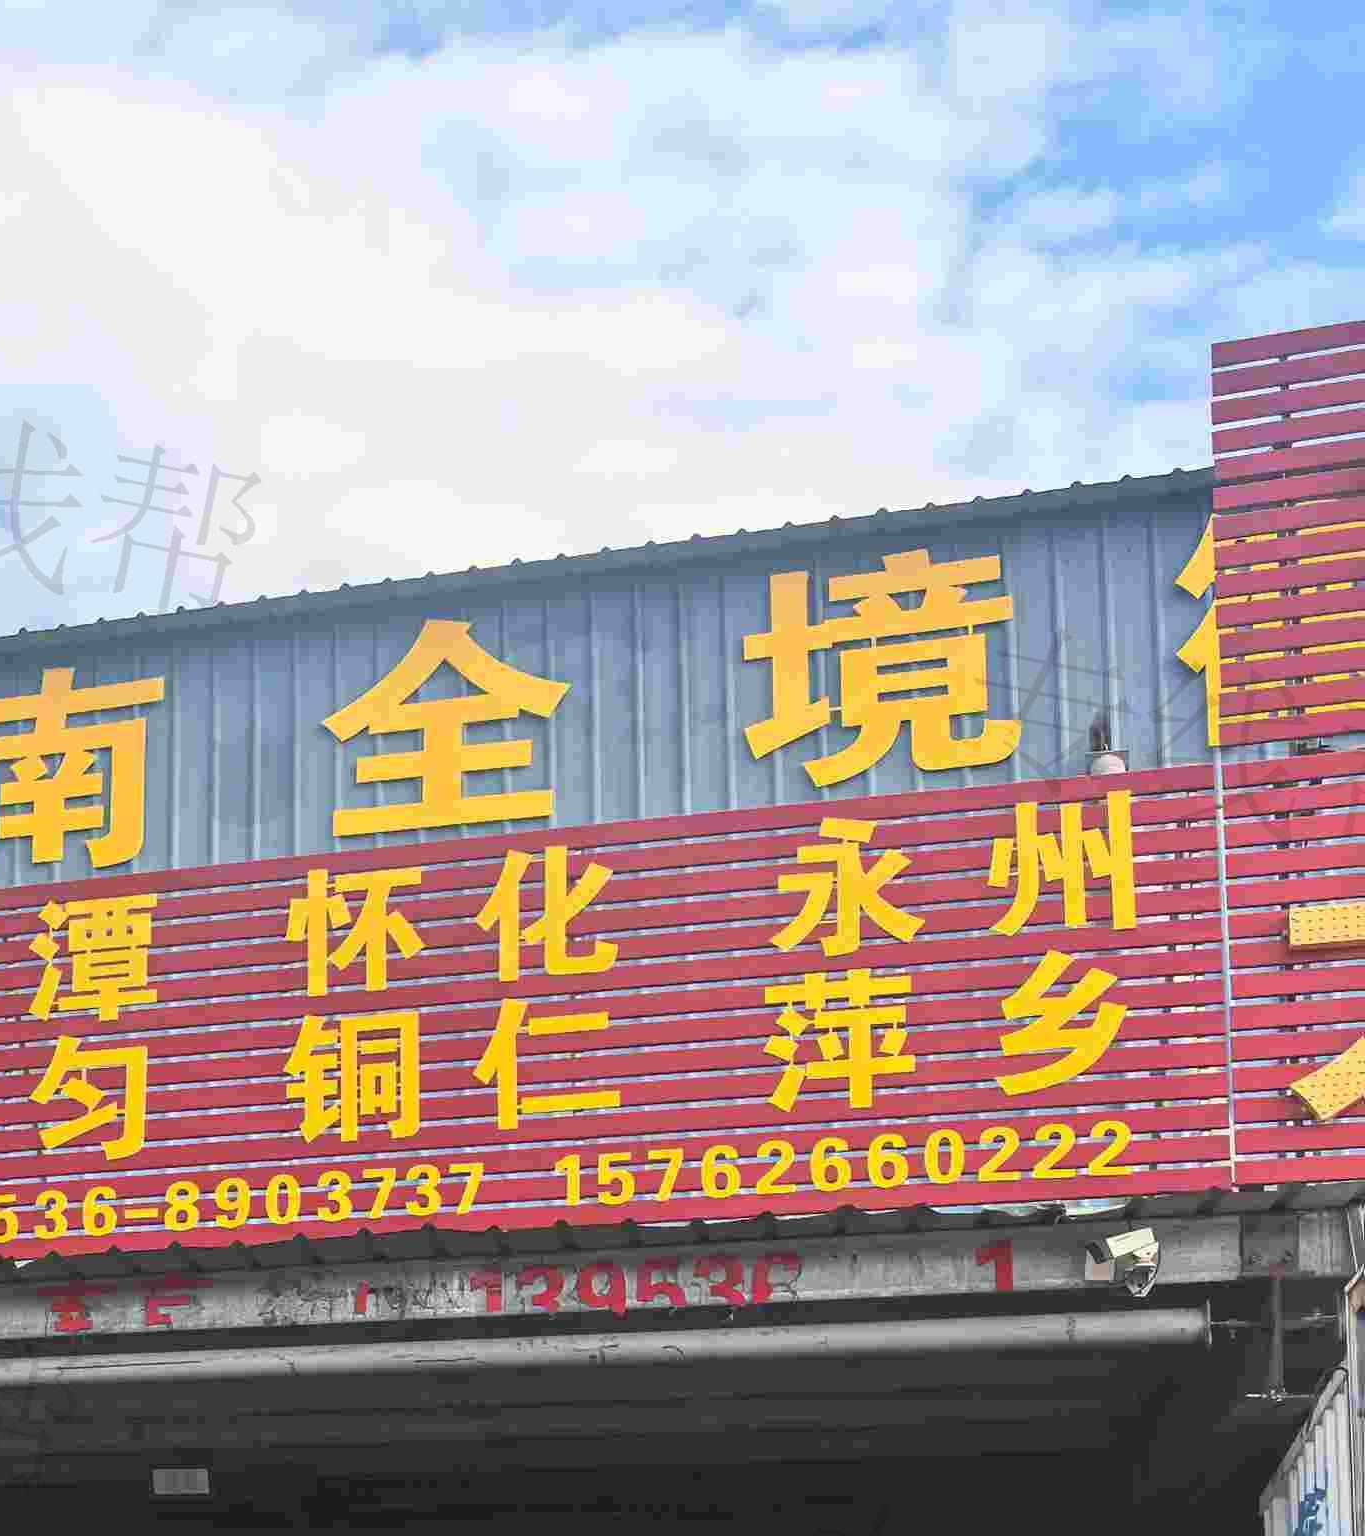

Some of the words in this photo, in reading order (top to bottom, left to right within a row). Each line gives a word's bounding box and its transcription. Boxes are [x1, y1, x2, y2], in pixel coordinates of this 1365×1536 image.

[285, 844, 621, 998] 怀化
[768, 790, 1138, 958] 永州
[284, 998, 622, 1145] 铜仁
[763, 949, 1129, 1113] 萍乡
[554, 1120, 1135, 1207] 15762660222
